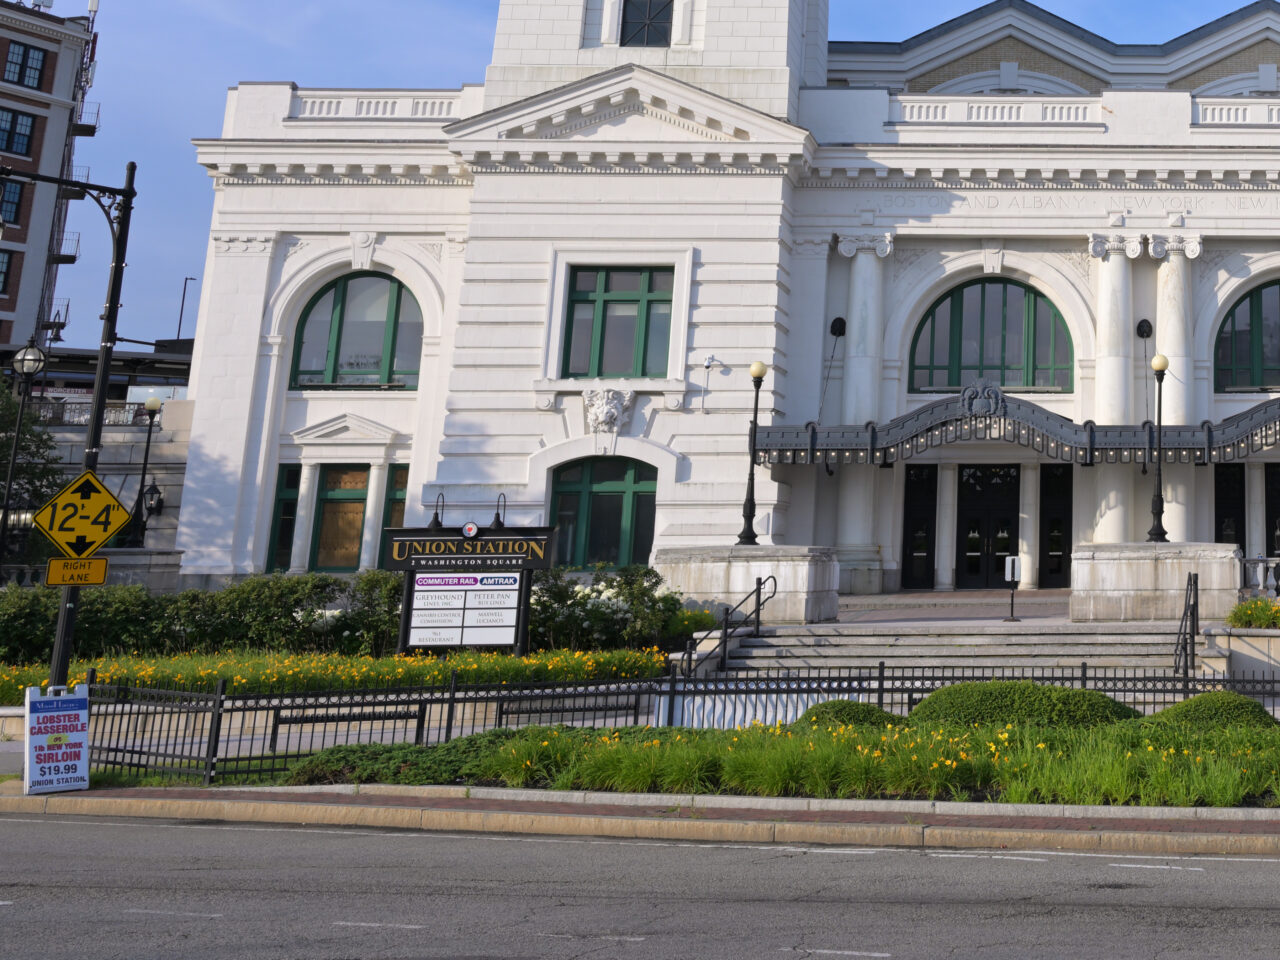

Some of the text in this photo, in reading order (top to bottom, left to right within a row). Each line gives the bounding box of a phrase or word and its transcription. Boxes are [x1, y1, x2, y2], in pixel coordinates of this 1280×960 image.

[882, 195, 953, 208] BOSTON
[959, 195, 1000, 209] AND
[1007, 195, 1088, 209] ALBANY
[1109, 196, 1153, 209] NEW
[1157, 196, 1205, 210] YORK
[1225, 196, 1269, 210] NEW
[392, 540, 547, 560] UNION STATION
[62, 562, 93, 570] RIGHT
[62, 574, 90, 582] LANE
[36, 713, 80, 725] LOBSTER
[30, 723, 87, 736] CASSEROLE
[36, 750, 81, 764] SIRLOIN
[40, 764, 77, 777] $19.99
[32, 776, 86, 787] UNION STATION
